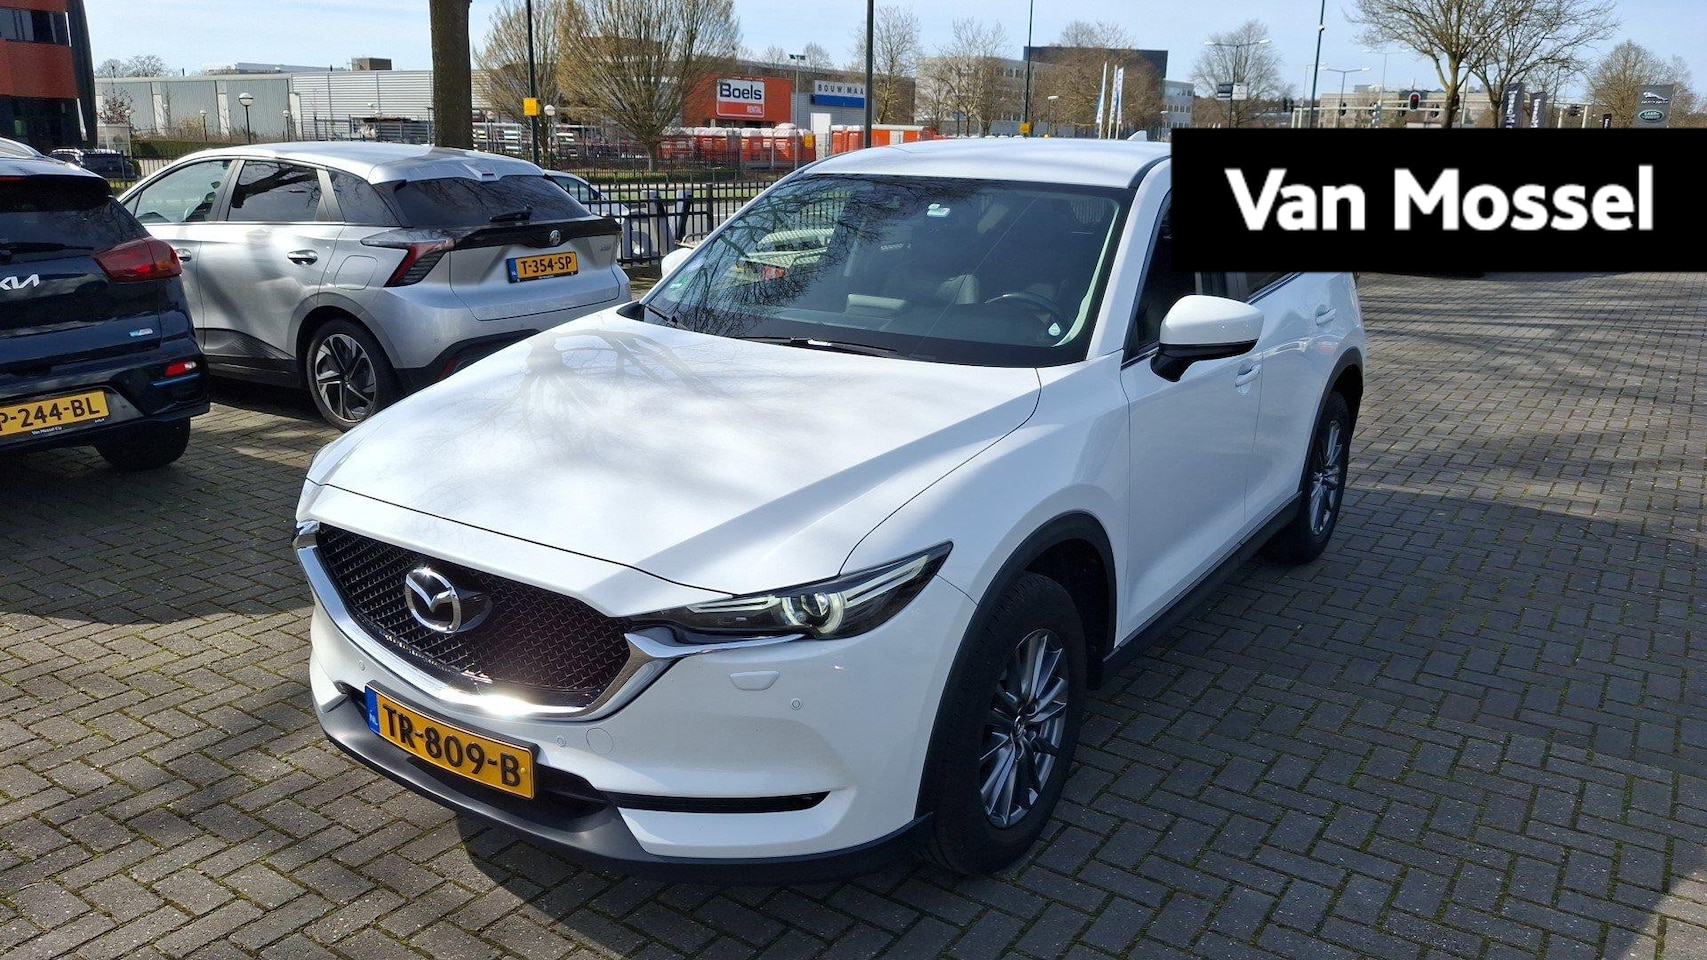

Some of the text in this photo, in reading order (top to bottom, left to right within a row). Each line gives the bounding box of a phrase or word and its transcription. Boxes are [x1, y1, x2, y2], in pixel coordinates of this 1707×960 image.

[720, 82, 762, 100] Boels
[521, 256, 572, 275] T-354-SP
[383, 703, 521, 788] TR-809-B
